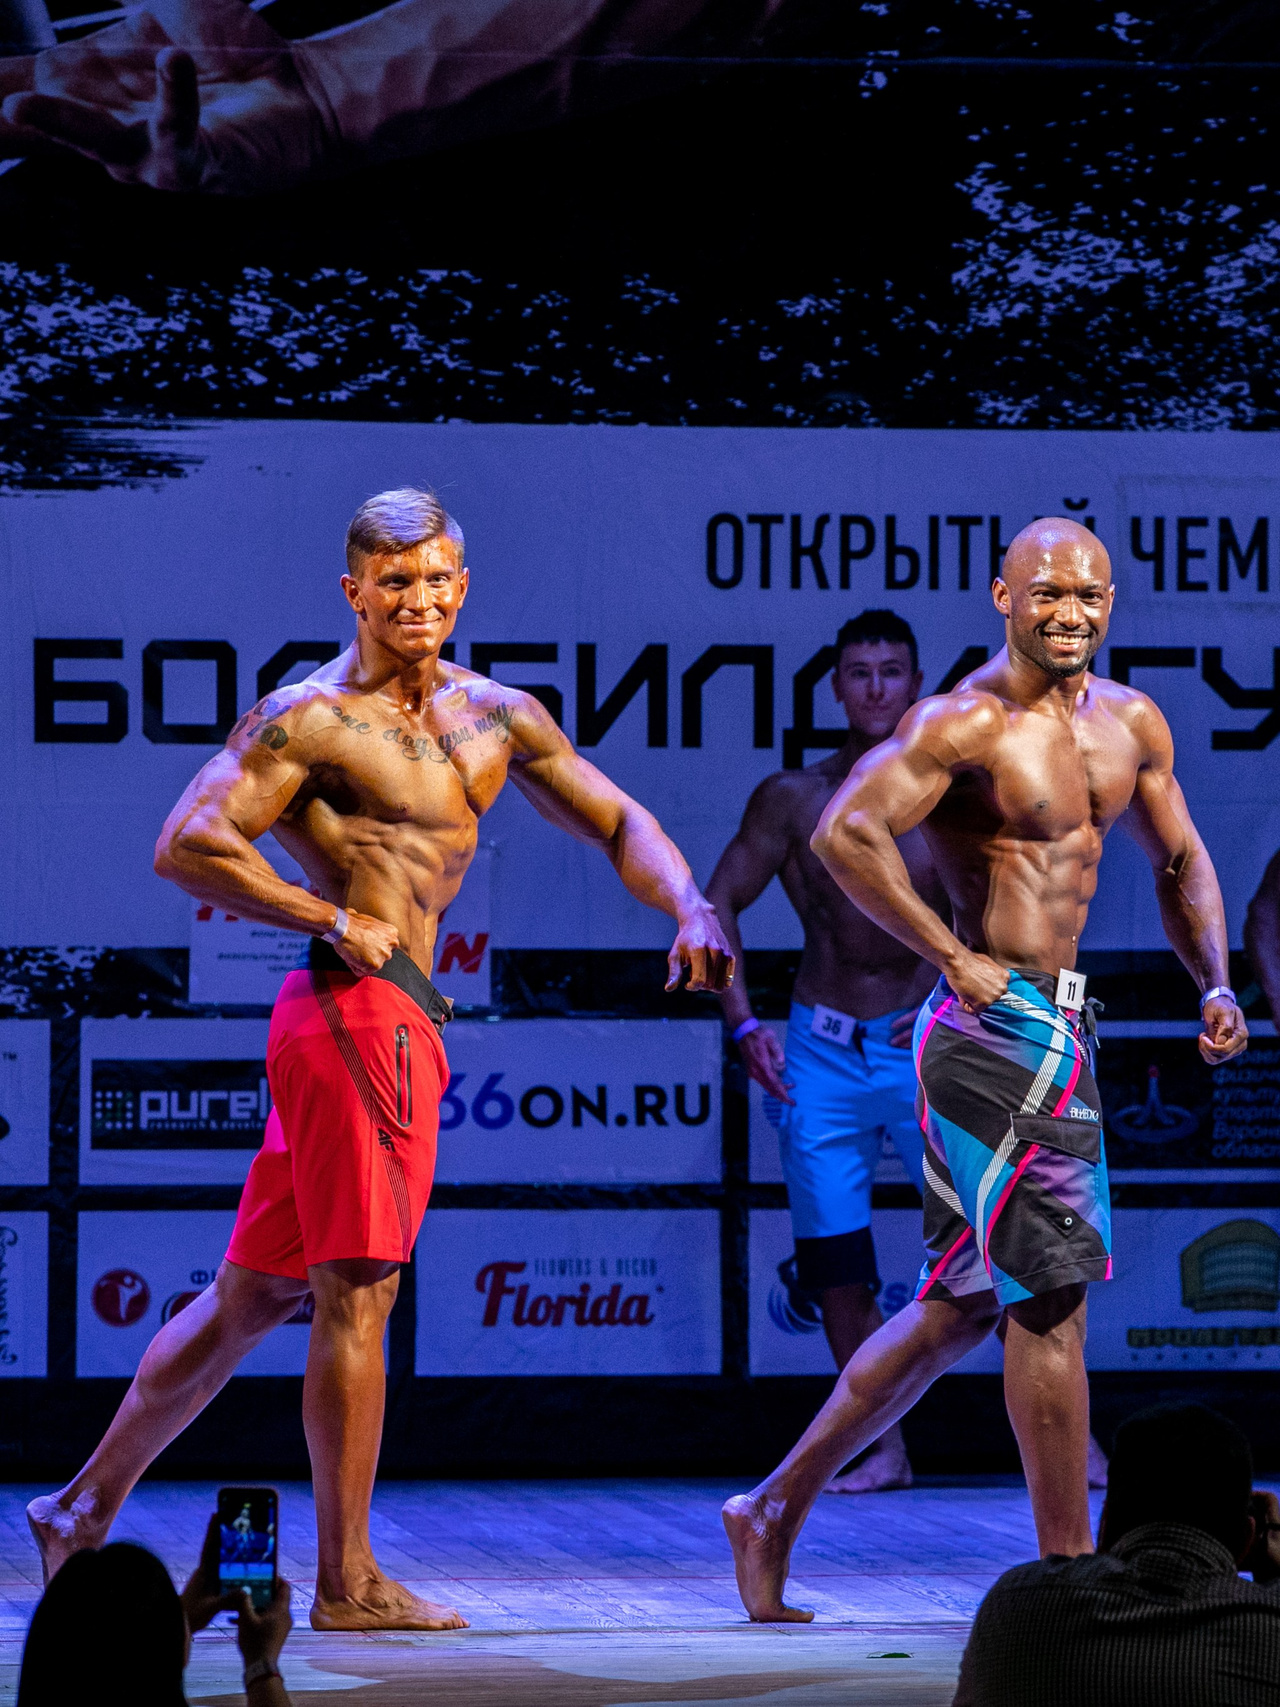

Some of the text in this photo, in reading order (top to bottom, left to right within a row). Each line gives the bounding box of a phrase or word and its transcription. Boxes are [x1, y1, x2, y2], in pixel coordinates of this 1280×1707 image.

[706, 497, 1096, 591] ОТКРЫТ
[1067, 980, 1077, 1002] 11
[822, 1015, 842, 1036] 36
[475, 1260, 655, 1327] Florida
